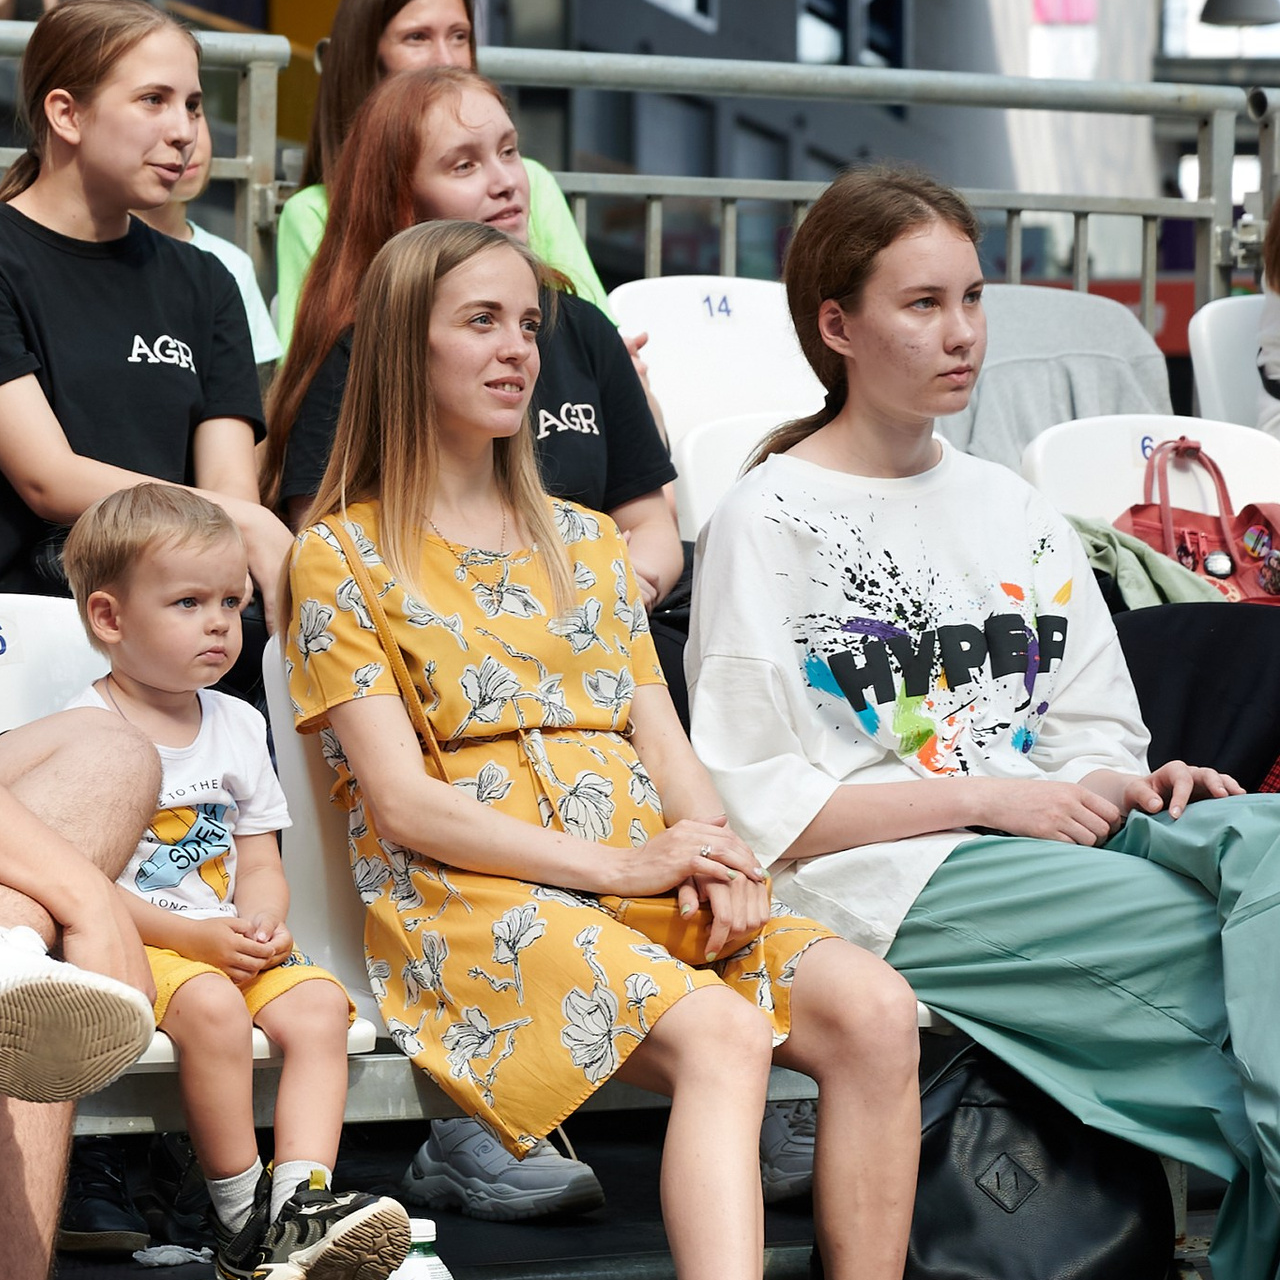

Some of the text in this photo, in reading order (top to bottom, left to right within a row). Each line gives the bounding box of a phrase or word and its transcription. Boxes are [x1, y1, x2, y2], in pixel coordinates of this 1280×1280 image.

[703, 295, 731, 317] 14
[127, 334, 197, 374] AGR
[537, 402, 600, 440] AGR
[1140, 436, 1154, 460] 6
[167, 778, 219, 800] TO THE
